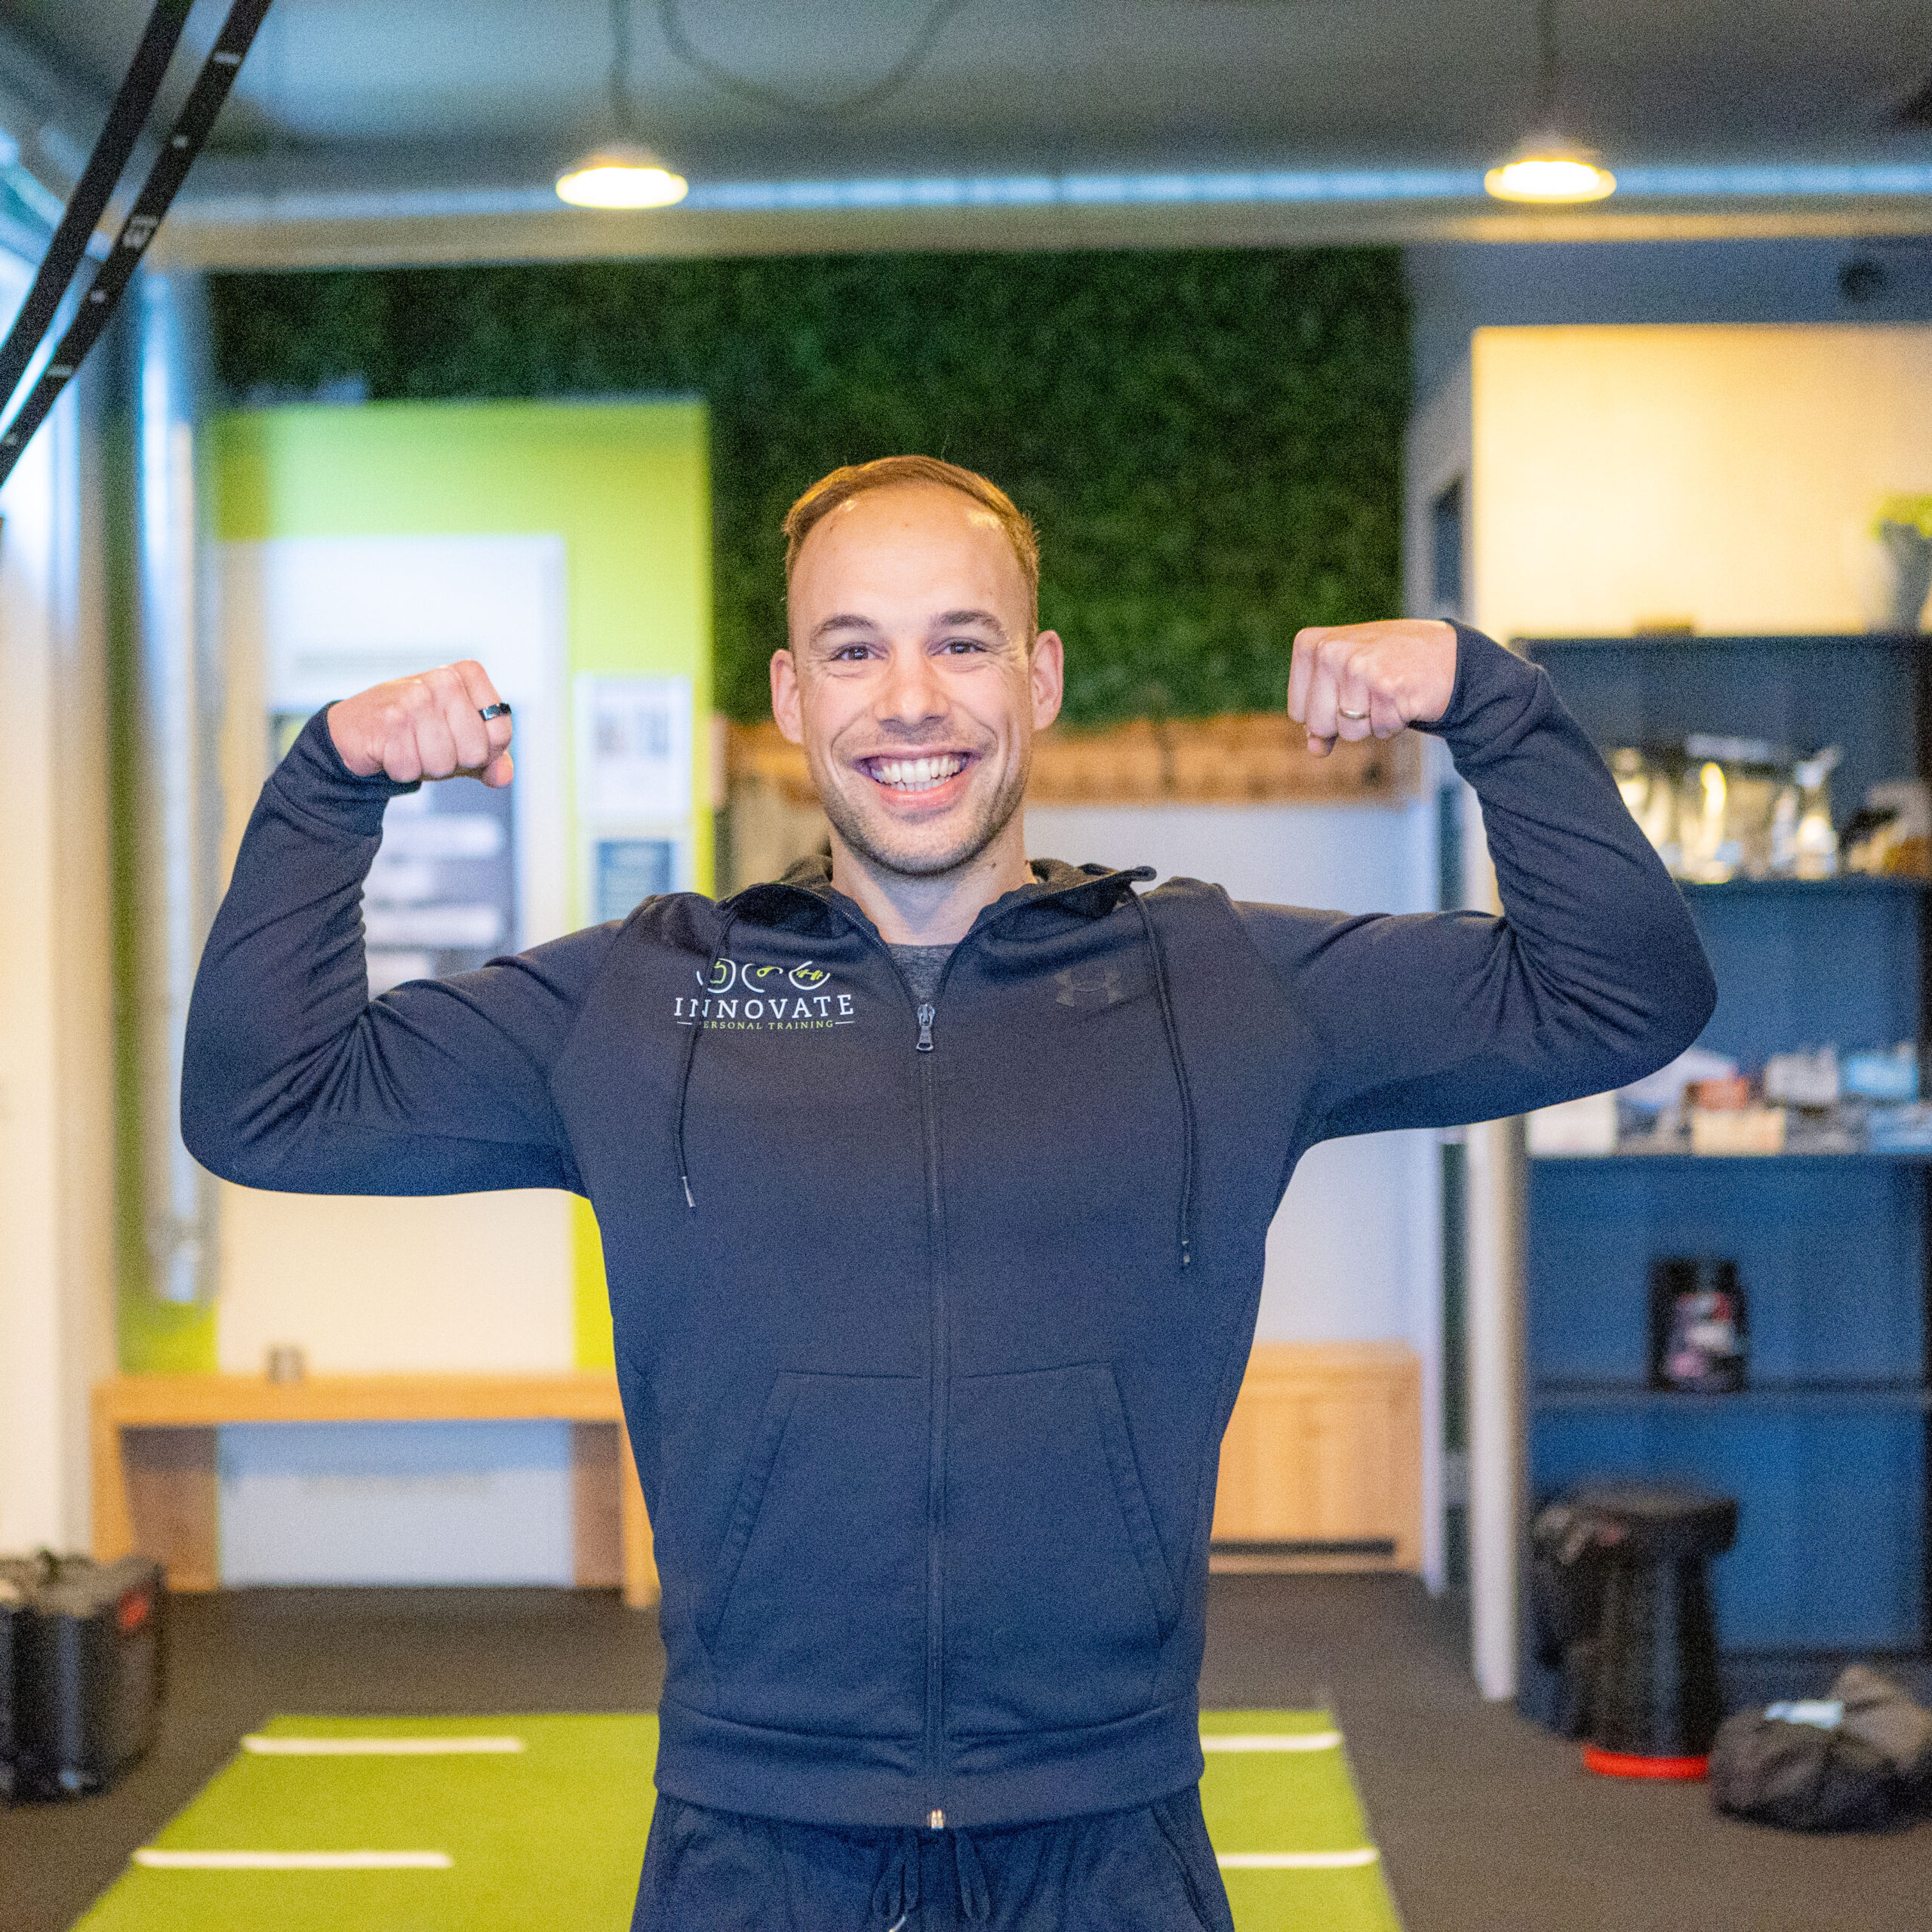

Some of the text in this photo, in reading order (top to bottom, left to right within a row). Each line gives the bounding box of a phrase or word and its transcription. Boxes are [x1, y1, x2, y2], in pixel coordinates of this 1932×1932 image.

[674, 994, 854, 1019] INNOVATE
[697, 1020, 834, 1030] ERSONAL TRAINING
